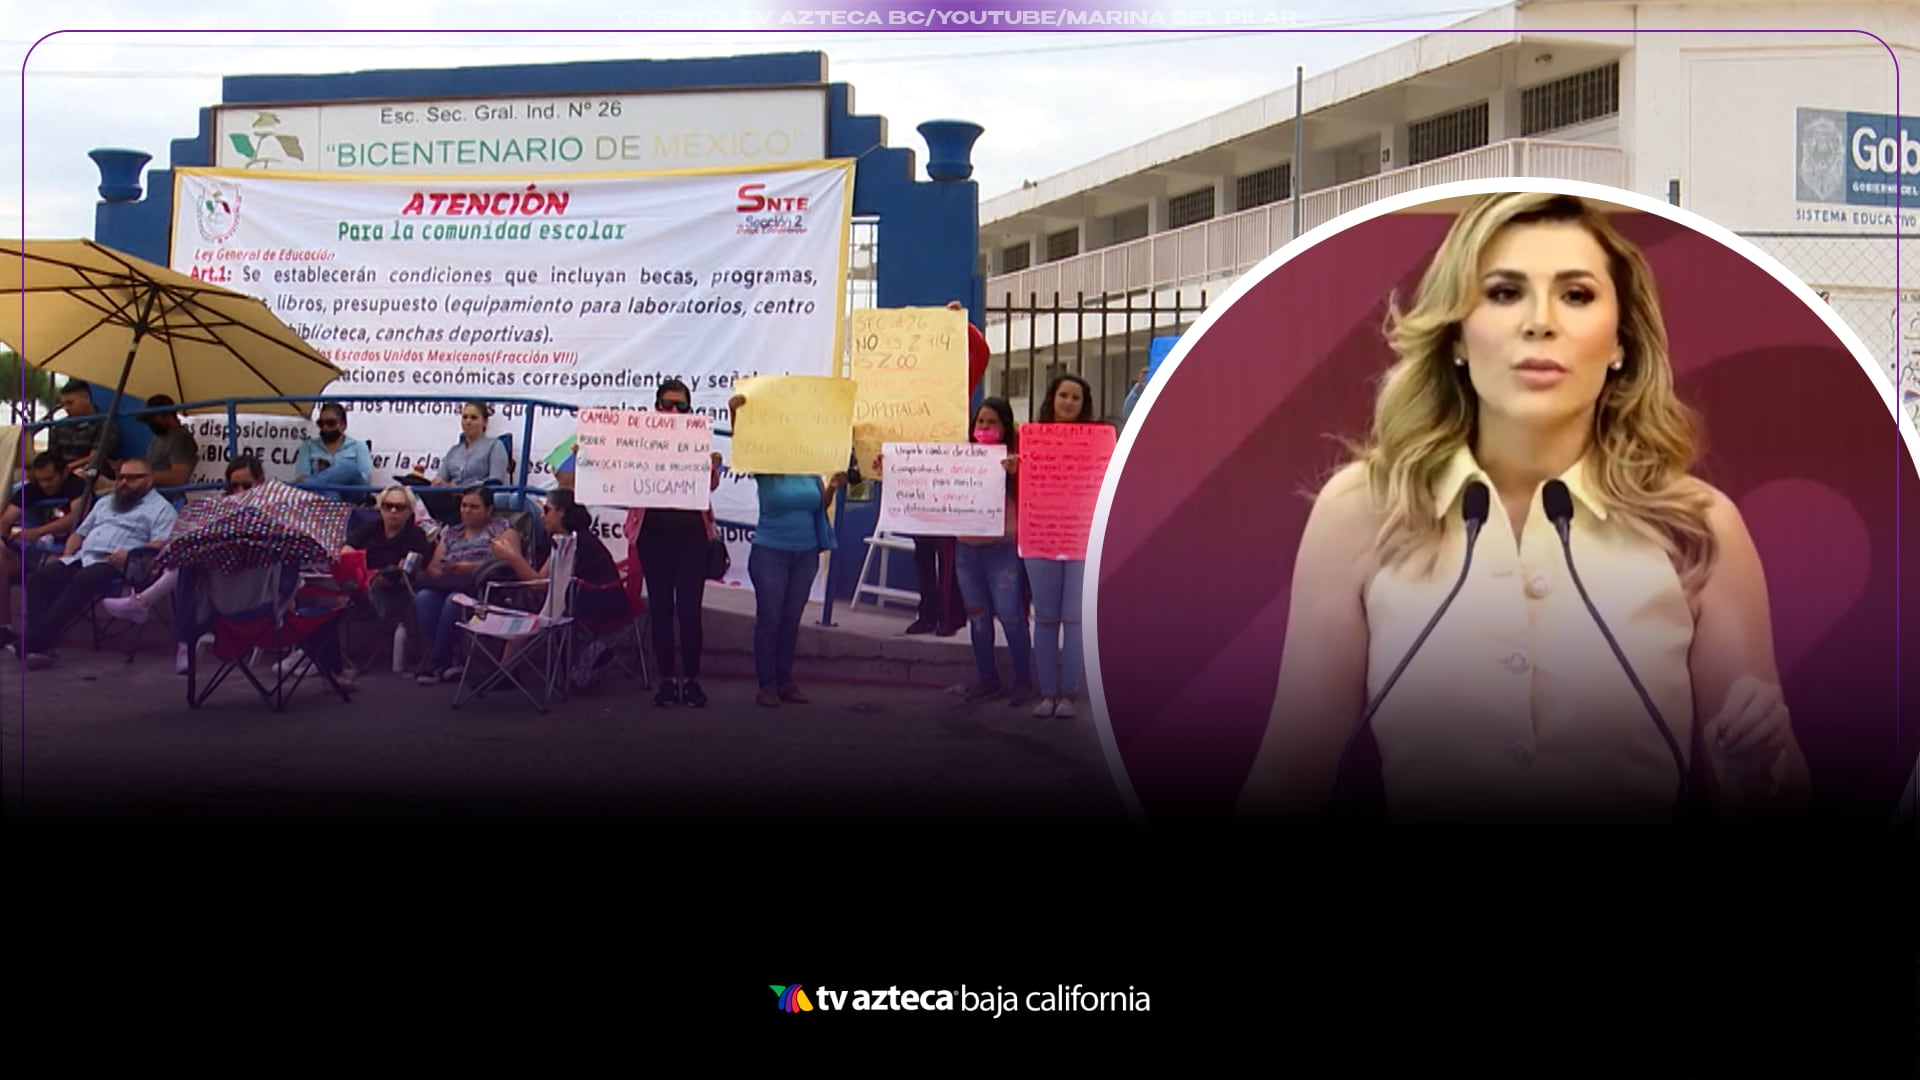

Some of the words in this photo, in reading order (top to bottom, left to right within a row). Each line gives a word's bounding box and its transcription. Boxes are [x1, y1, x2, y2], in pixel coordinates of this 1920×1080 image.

[380, 107, 419, 124] Esc.
[426, 106, 466, 122] Sec.
[474, 104, 518, 121] Gral.
[526, 103, 560, 119] Ind.
[598, 101, 622, 117] 26
[595, 135, 641, 160] DE
[402, 183, 570, 216] ATENCIÓN
[736, 183, 809, 213] SNTE
[1795, 209, 1848, 222] SISTEMA
[338, 221, 383, 241] Para
[391, 220, 414, 240] la
[422, 219, 531, 240] comunidad
[539, 219, 627, 239] escolar
[194, 249, 215, 262] Ley
[216, 249, 260, 262] General
[262, 249, 275, 262] de
[277, 248, 335, 262] Educación
[190, 264, 232, 283] Art.1:
[242, 265, 261, 282] Se
[274, 265, 376, 283] establecerán
[389, 266, 492, 284] condiciones
[505, 271, 538, 289] que
[550, 266, 626, 287] incluyan
[640, 266, 699, 288] becas,
[711, 268, 818, 289] programas,
[277, 294, 327, 313] libros,
[333, 297, 437, 316] presupuesto
[444, 295, 573, 316] (equipamiento
[580, 299, 621, 318] para
[628, 297, 748, 317] laboratorios,
[753, 298, 815, 315] centro
[376, 325, 443, 343] canchas
[449, 325, 554, 345] deportivas).
[856, 333, 879, 352] NO
[334, 349, 380, 362] Estados
[383, 350, 424, 363] Unidos
[550, 350, 579, 365] VIII)
[412, 366, 515, 385] económicas
[691, 376, 701, 391] y
[580, 411, 620, 426] CAMBIO
[628, 416, 639, 429] DE
[645, 416, 675, 430] CLAVE
[395, 452, 410, 469] la
[602, 484, 615, 493] DE
